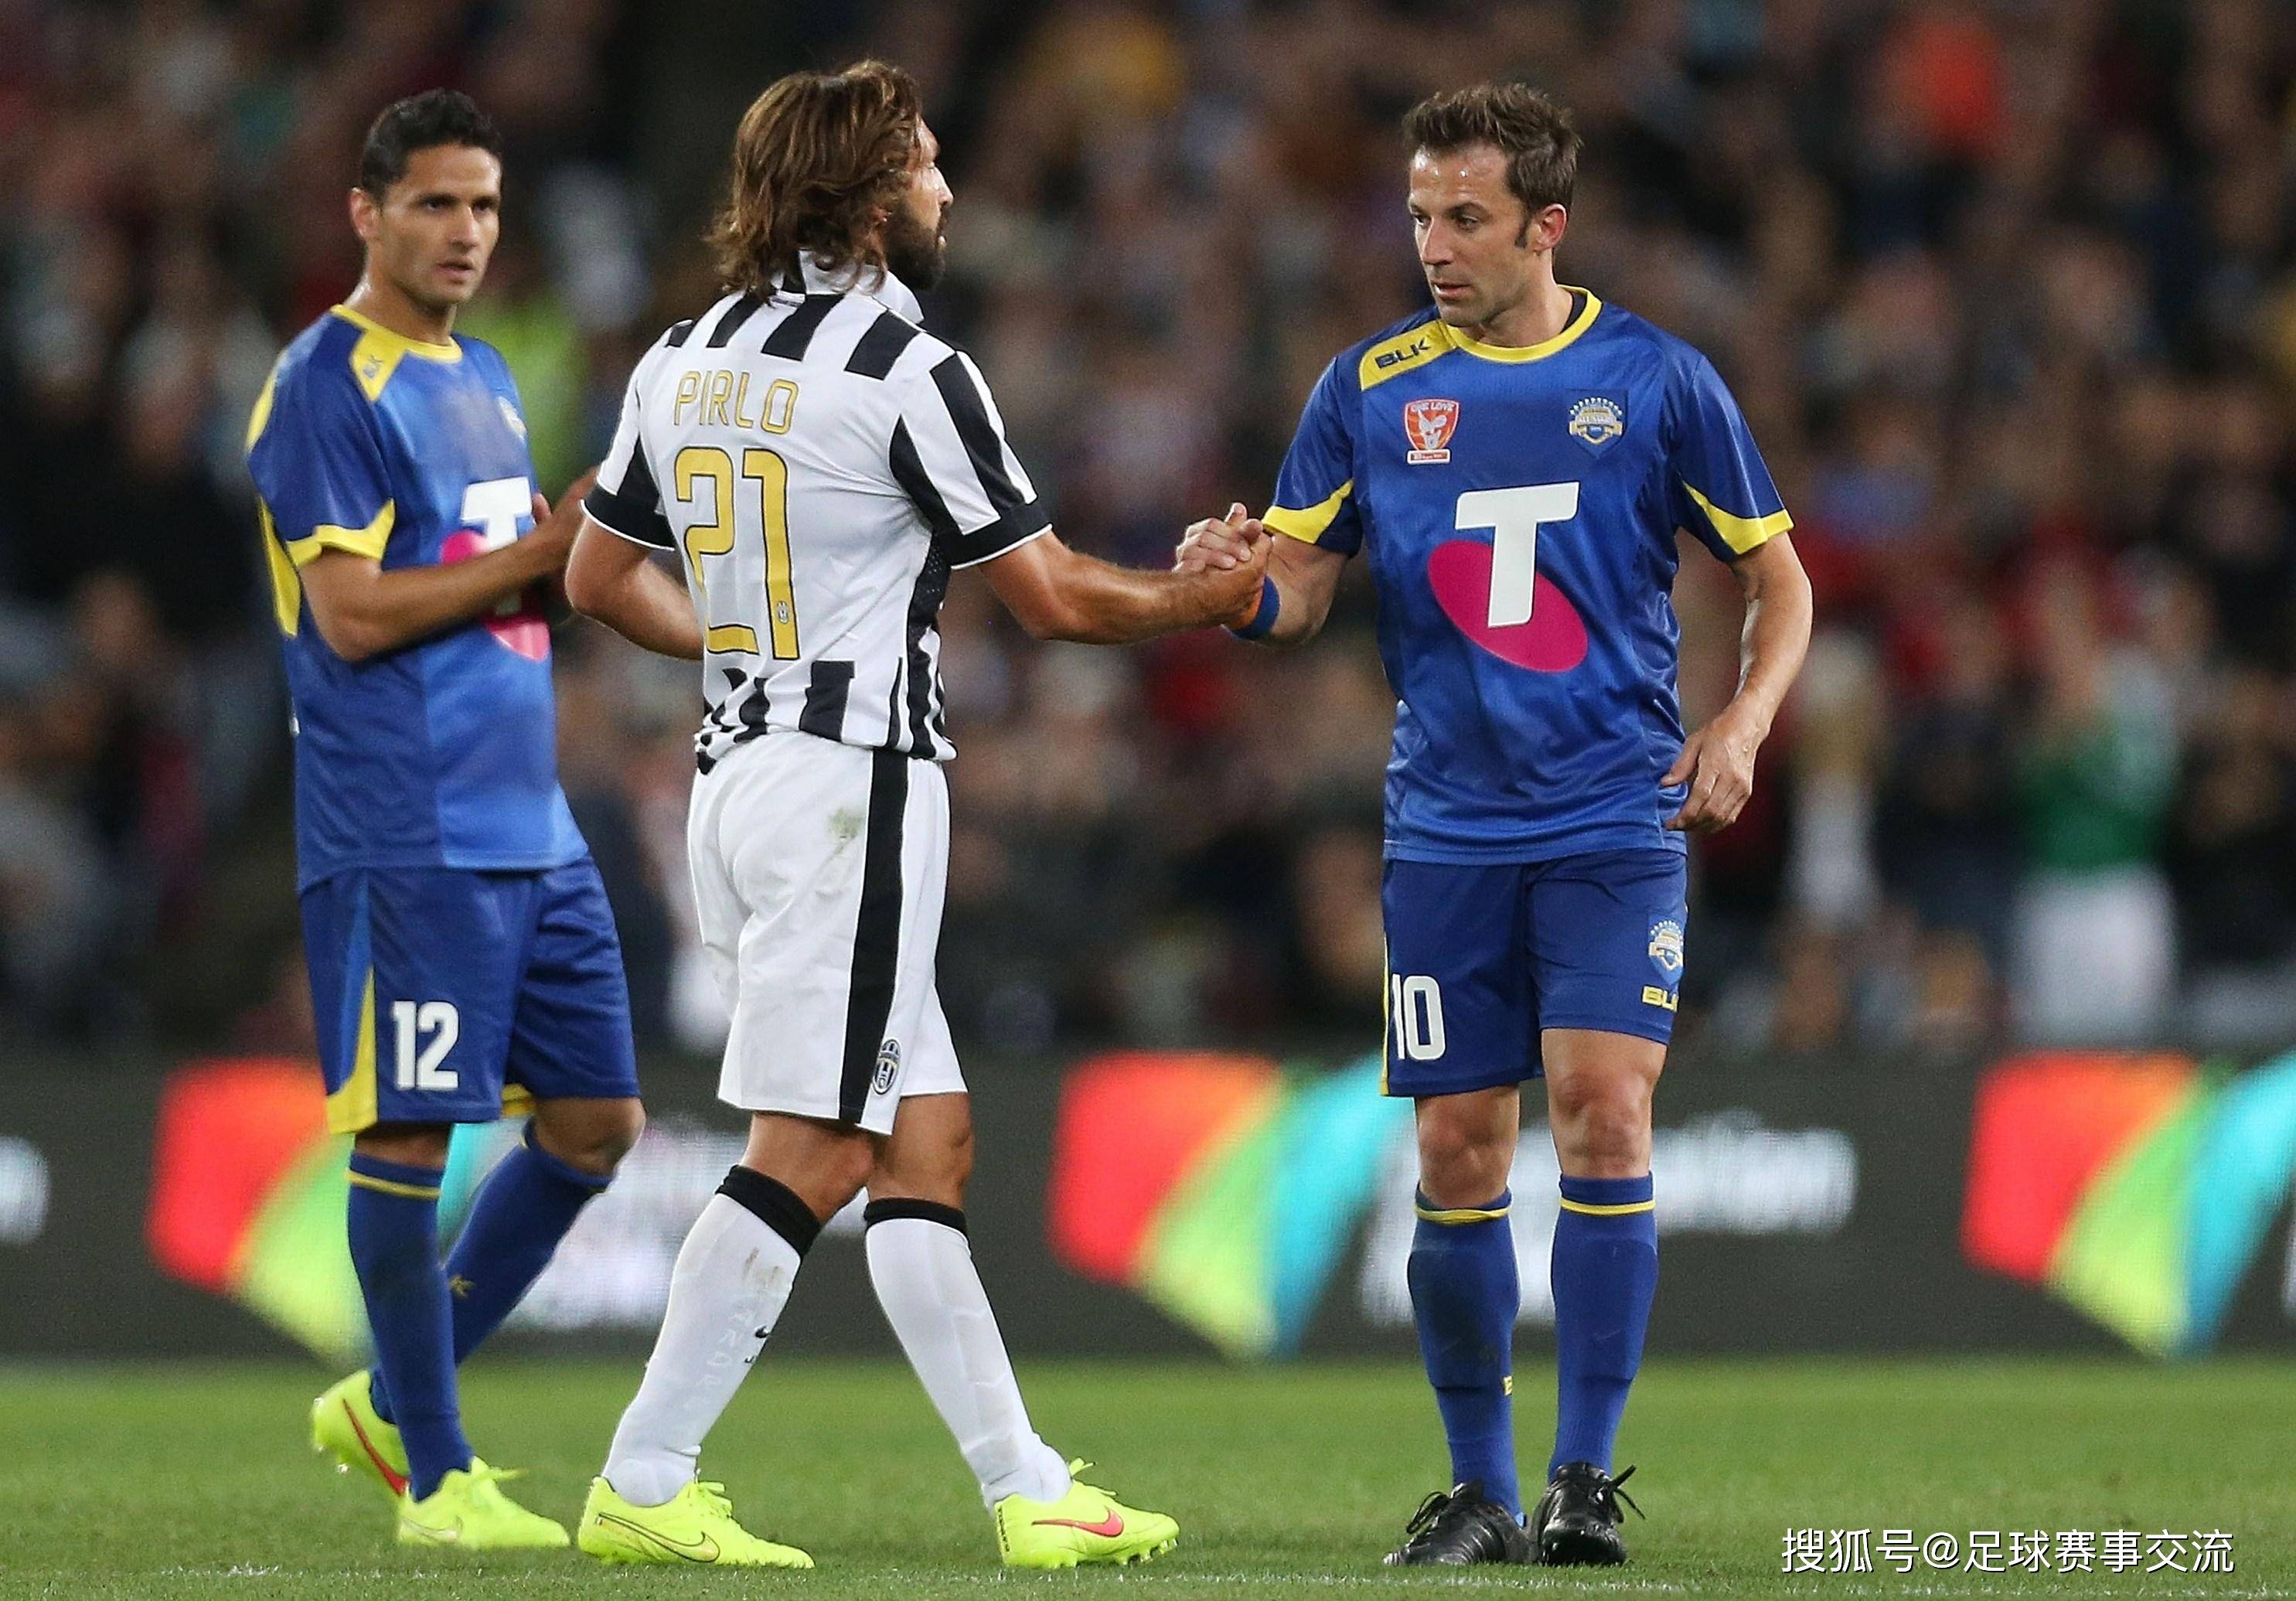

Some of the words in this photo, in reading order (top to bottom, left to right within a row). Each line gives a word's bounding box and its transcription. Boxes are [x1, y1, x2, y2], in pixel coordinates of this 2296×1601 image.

[1375, 337, 1431, 369] BLK
[674, 370, 799, 435] PIRLO
[674, 446, 800, 661] 21
[1455, 481, 1580, 628] T
[392, 1000, 459, 1092] 12
[1392, 974, 1446, 1061] 10
